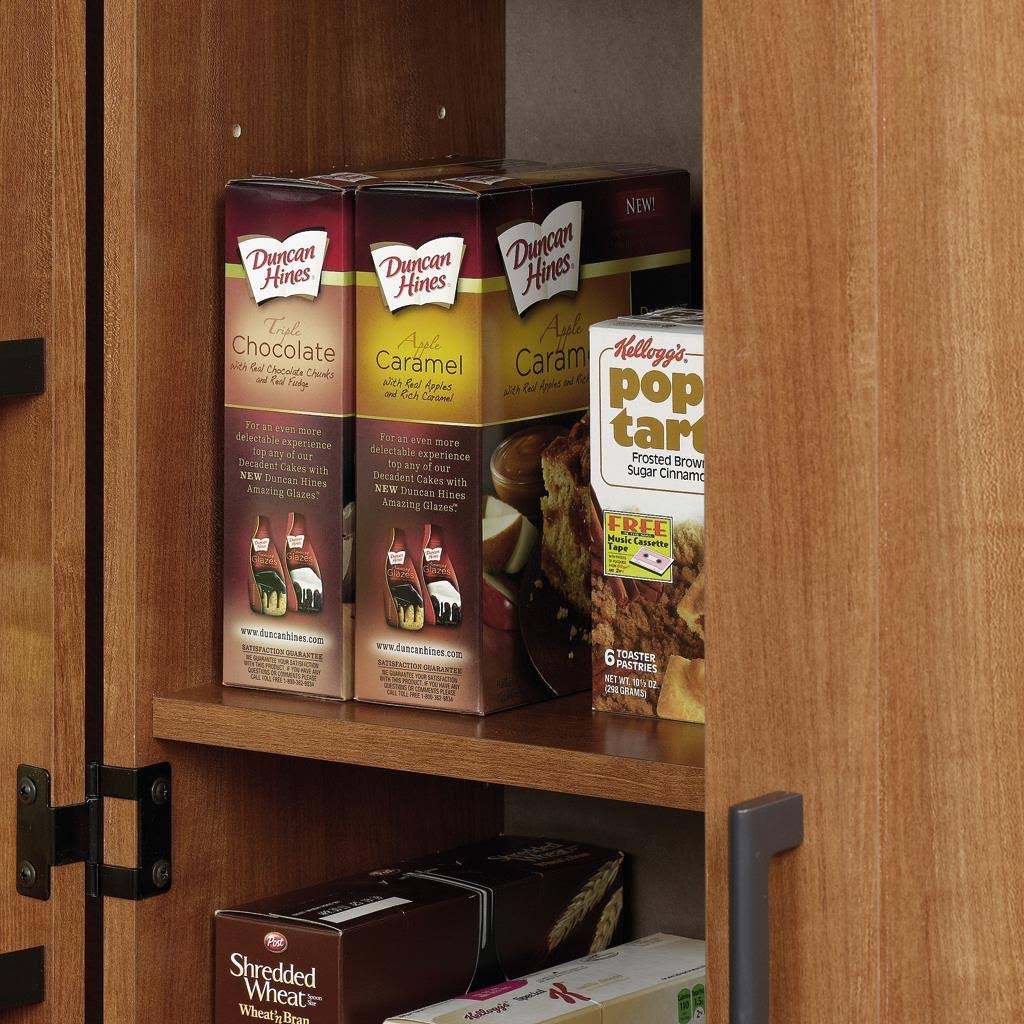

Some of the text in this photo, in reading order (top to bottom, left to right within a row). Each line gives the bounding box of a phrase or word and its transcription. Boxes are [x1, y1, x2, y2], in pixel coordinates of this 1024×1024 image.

[626, 197, 656, 215] NEW!
[506, 222, 574, 270] Duncan
[246, 244, 315, 270] Duncan
[379, 251, 451, 278] Duncan
[260, 265, 310, 290] Hines
[522, 253, 570, 296] Hines
[394, 273, 446, 298] Hines
[264, 316, 302, 343] Triple
[232, 335, 336, 362] Chocolate
[613, 334, 686, 368] Kellogg's
[376, 350, 463, 375] Caramel
[266, 365, 335, 379] Chocolate Chunks
[288, 378, 309, 391] Fudge
[425, 381, 452, 392] Apples
[609, 367, 704, 414] pop
[400, 389, 454, 403] Rich Caramel
[298, 427, 322, 437] more
[236, 432, 332, 452] delectable experience
[239, 458, 329, 475] Decadent Cakes with
[632, 452, 671, 466] Frosted
[240, 471, 327, 488] NEW Duncan Hines
[373, 471, 467, 487] Decadent Cakes with
[627, 464, 704, 481] Sugar Cinnamo
[375, 484, 466, 500] NEW Duncan Hines
[382, 497, 421, 511] Amazing
[608, 515, 668, 537] FREE
[607, 534, 632, 545] Music
[633, 536, 669, 549] Cassette
[608, 542, 629, 553] Tape
[240, 627, 324, 645] www.duncanhines.com
[241, 644, 284, 656] SATISFACTION
[376, 641, 463, 659] www.duncanhines.com
[617, 649, 656, 663] TOASTER
[377, 659, 422, 671] SATISFACTION
[617, 660, 657, 674] PASTRIES
[604, 674, 618, 685] NET
[266, 936, 284, 948] Post
[229, 953, 317, 989] Shredded
[243, 977, 307, 1008] Wheat
[512, 987, 547, 1002] Special
[548, 982, 592, 1004] K
[238, 1003, 310, 1024] Wheat'n Bran
[463, 999, 510, 1023] Kellogg's
